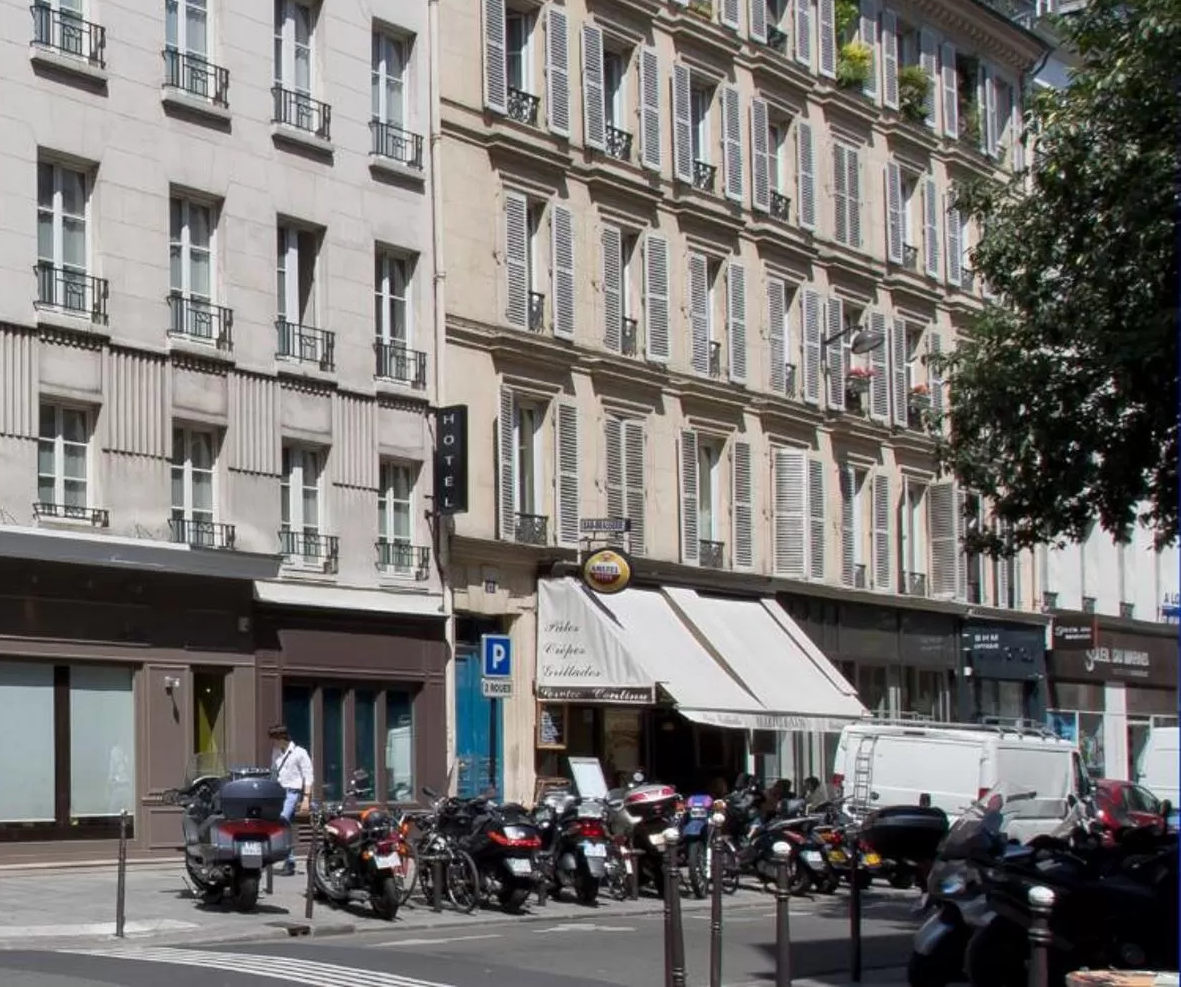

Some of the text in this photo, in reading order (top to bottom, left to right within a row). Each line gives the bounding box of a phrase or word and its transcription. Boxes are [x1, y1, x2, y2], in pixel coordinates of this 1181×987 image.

[443, 413, 455, 508] HOTEL
[492, 643, 506, 669] P
[542, 665, 602, 677] Grillades
[490, 684, 512, 693] ROUES
[591, 688, 649, 701] Continu
